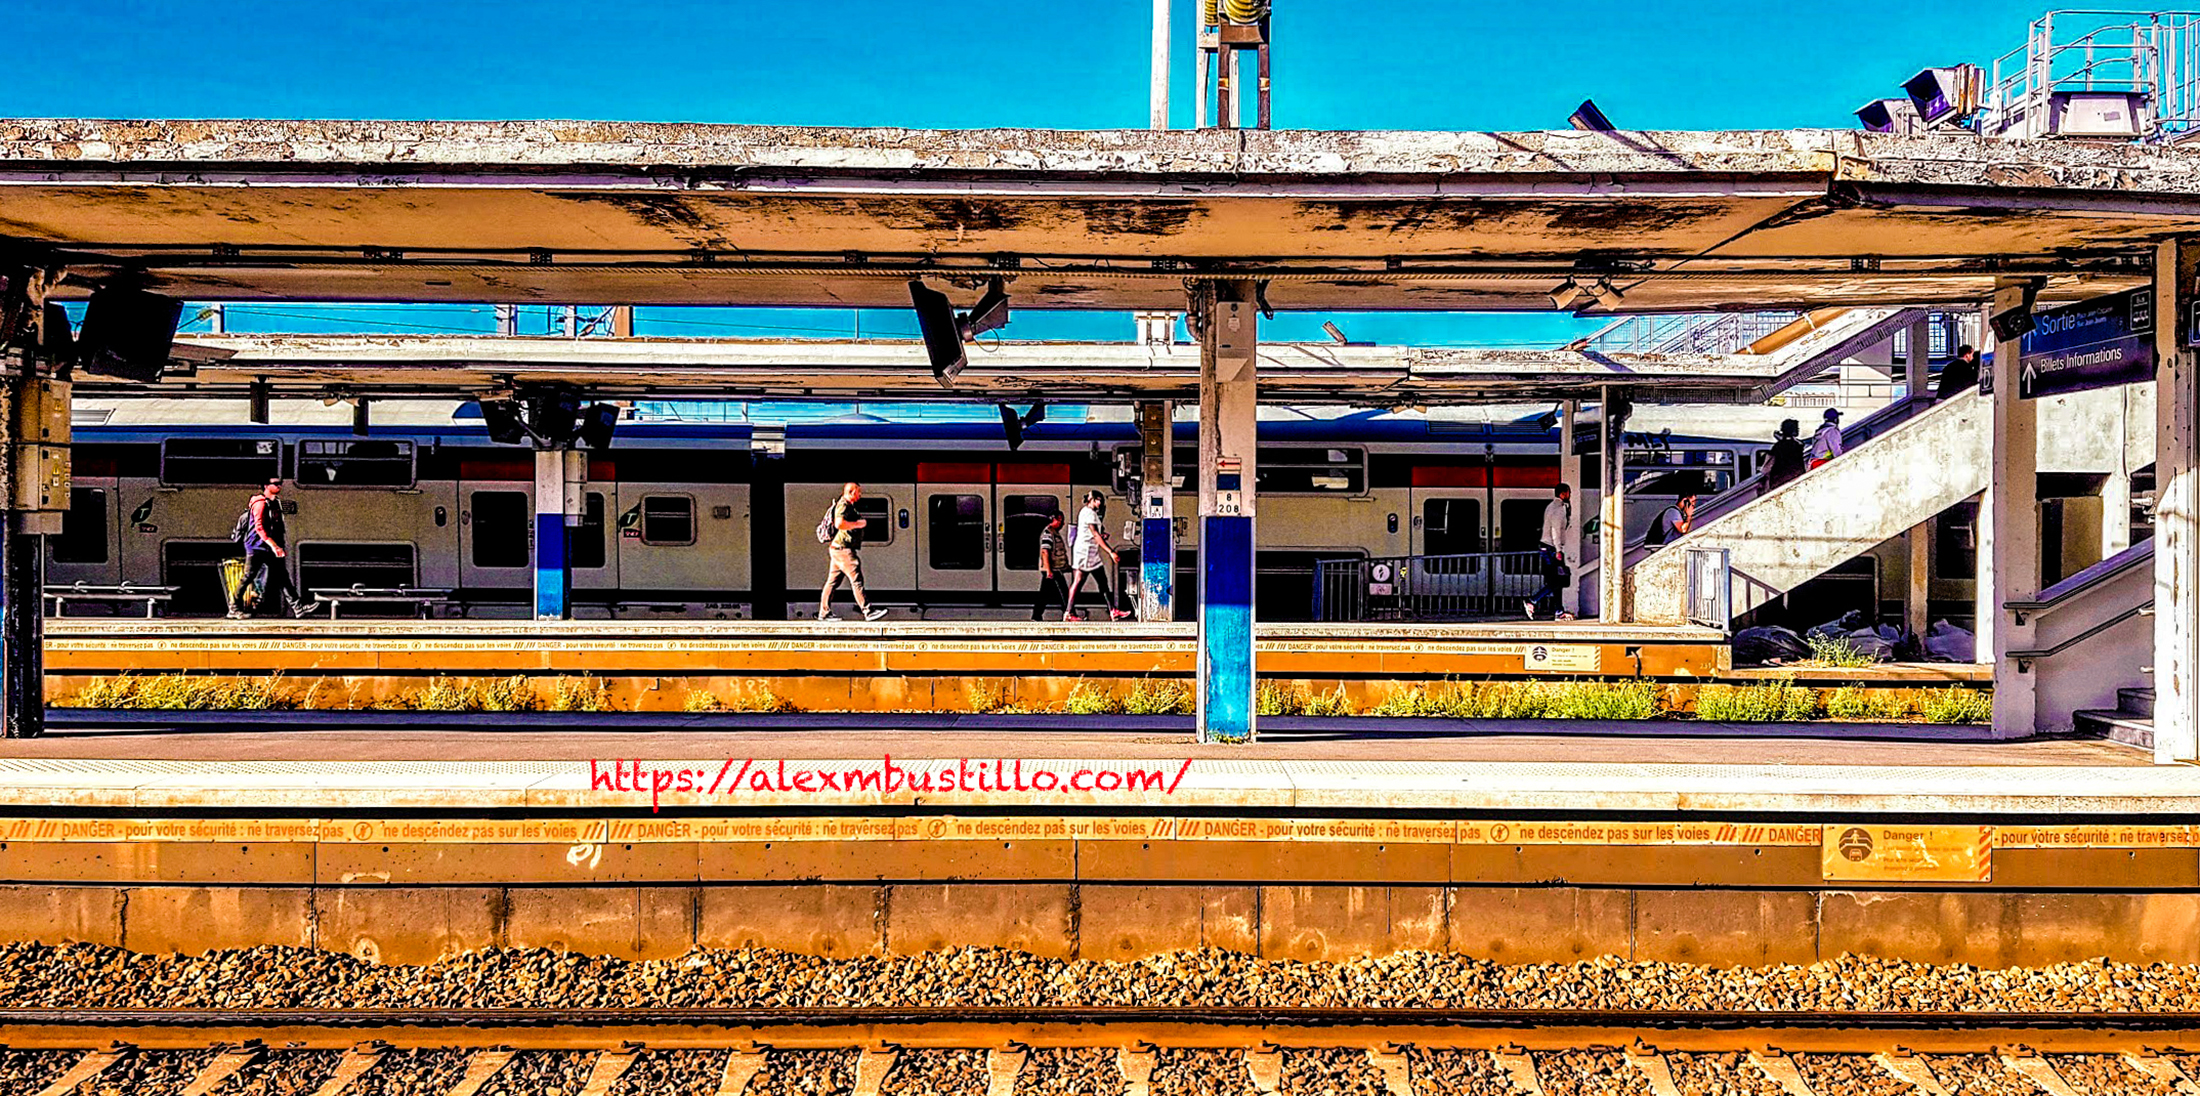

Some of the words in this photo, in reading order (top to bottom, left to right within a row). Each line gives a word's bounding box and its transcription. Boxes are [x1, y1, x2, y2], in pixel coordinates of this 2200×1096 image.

[2041, 310, 2076, 336] Sortie
[2040, 356, 2064, 373] Billets
[2066, 346, 2122, 368] Informations
[1226, 493, 1232, 502] 8
[1218, 504, 1240, 513] 208
[62, 823, 115, 837] DANGER
[126, 826, 154, 840] pour
[156, 824, 186, 836] votre
[190, 823, 236, 837] sécurité
[250, 826, 262, 836] ne
[265, 824, 319, 837] traversez
[323, 827, 344, 840] pas
[384, 826, 398, 837] ne
[400, 824, 469, 838] descendez
[472, 826, 494, 840] pas
[499, 826, 518, 838] sur
[522, 824, 540, 838] les
[544, 824, 576, 838] voies
[638, 824, 690, 838] DANGER
[702, 826, 730, 839] pour
[732, 824, 760, 836] votre
[765, 822, 812, 836] sécurité
[823, 825, 836, 836] ne
[840, 823, 894, 836] traversez
[898, 824, 918, 838] pas
[958, 824, 971, 834] ne
[976, 821, 1040, 834] descendez
[1044, 824, 1065, 838] pas
[1070, 824, 1088, 834] sur
[1092, 821, 1110, 834] les
[1114, 822, 1146, 834] voies
[1205, 822, 1256, 836] DANGER
[1267, 825, 1293, 838] pour
[1296, 823, 1326, 836] votre
[1329, 822, 1374, 837] sécurité
[1386, 826, 1399, 837] ne
[1403, 825, 1455, 838] traversez
[1460, 828, 1480, 840] pas
[1520, 828, 1534, 838] ne
[1538, 826, 1603, 840] descendez
[1608, 828, 1628, 842] pas
[1632, 828, 1652, 840] sur
[1656, 826, 1674, 840] les
[1678, 826, 1710, 840] voies
[1768, 828, 1821, 842] DANGER
[2002, 832, 2027, 846] pour
[2032, 831, 2060, 843] votre
[2064, 830, 2109, 843] sécurité
[2120, 832, 2134, 842] ne
[2138, 830, 2189, 843] traversez
[1883, 830, 1924, 842] Danger
